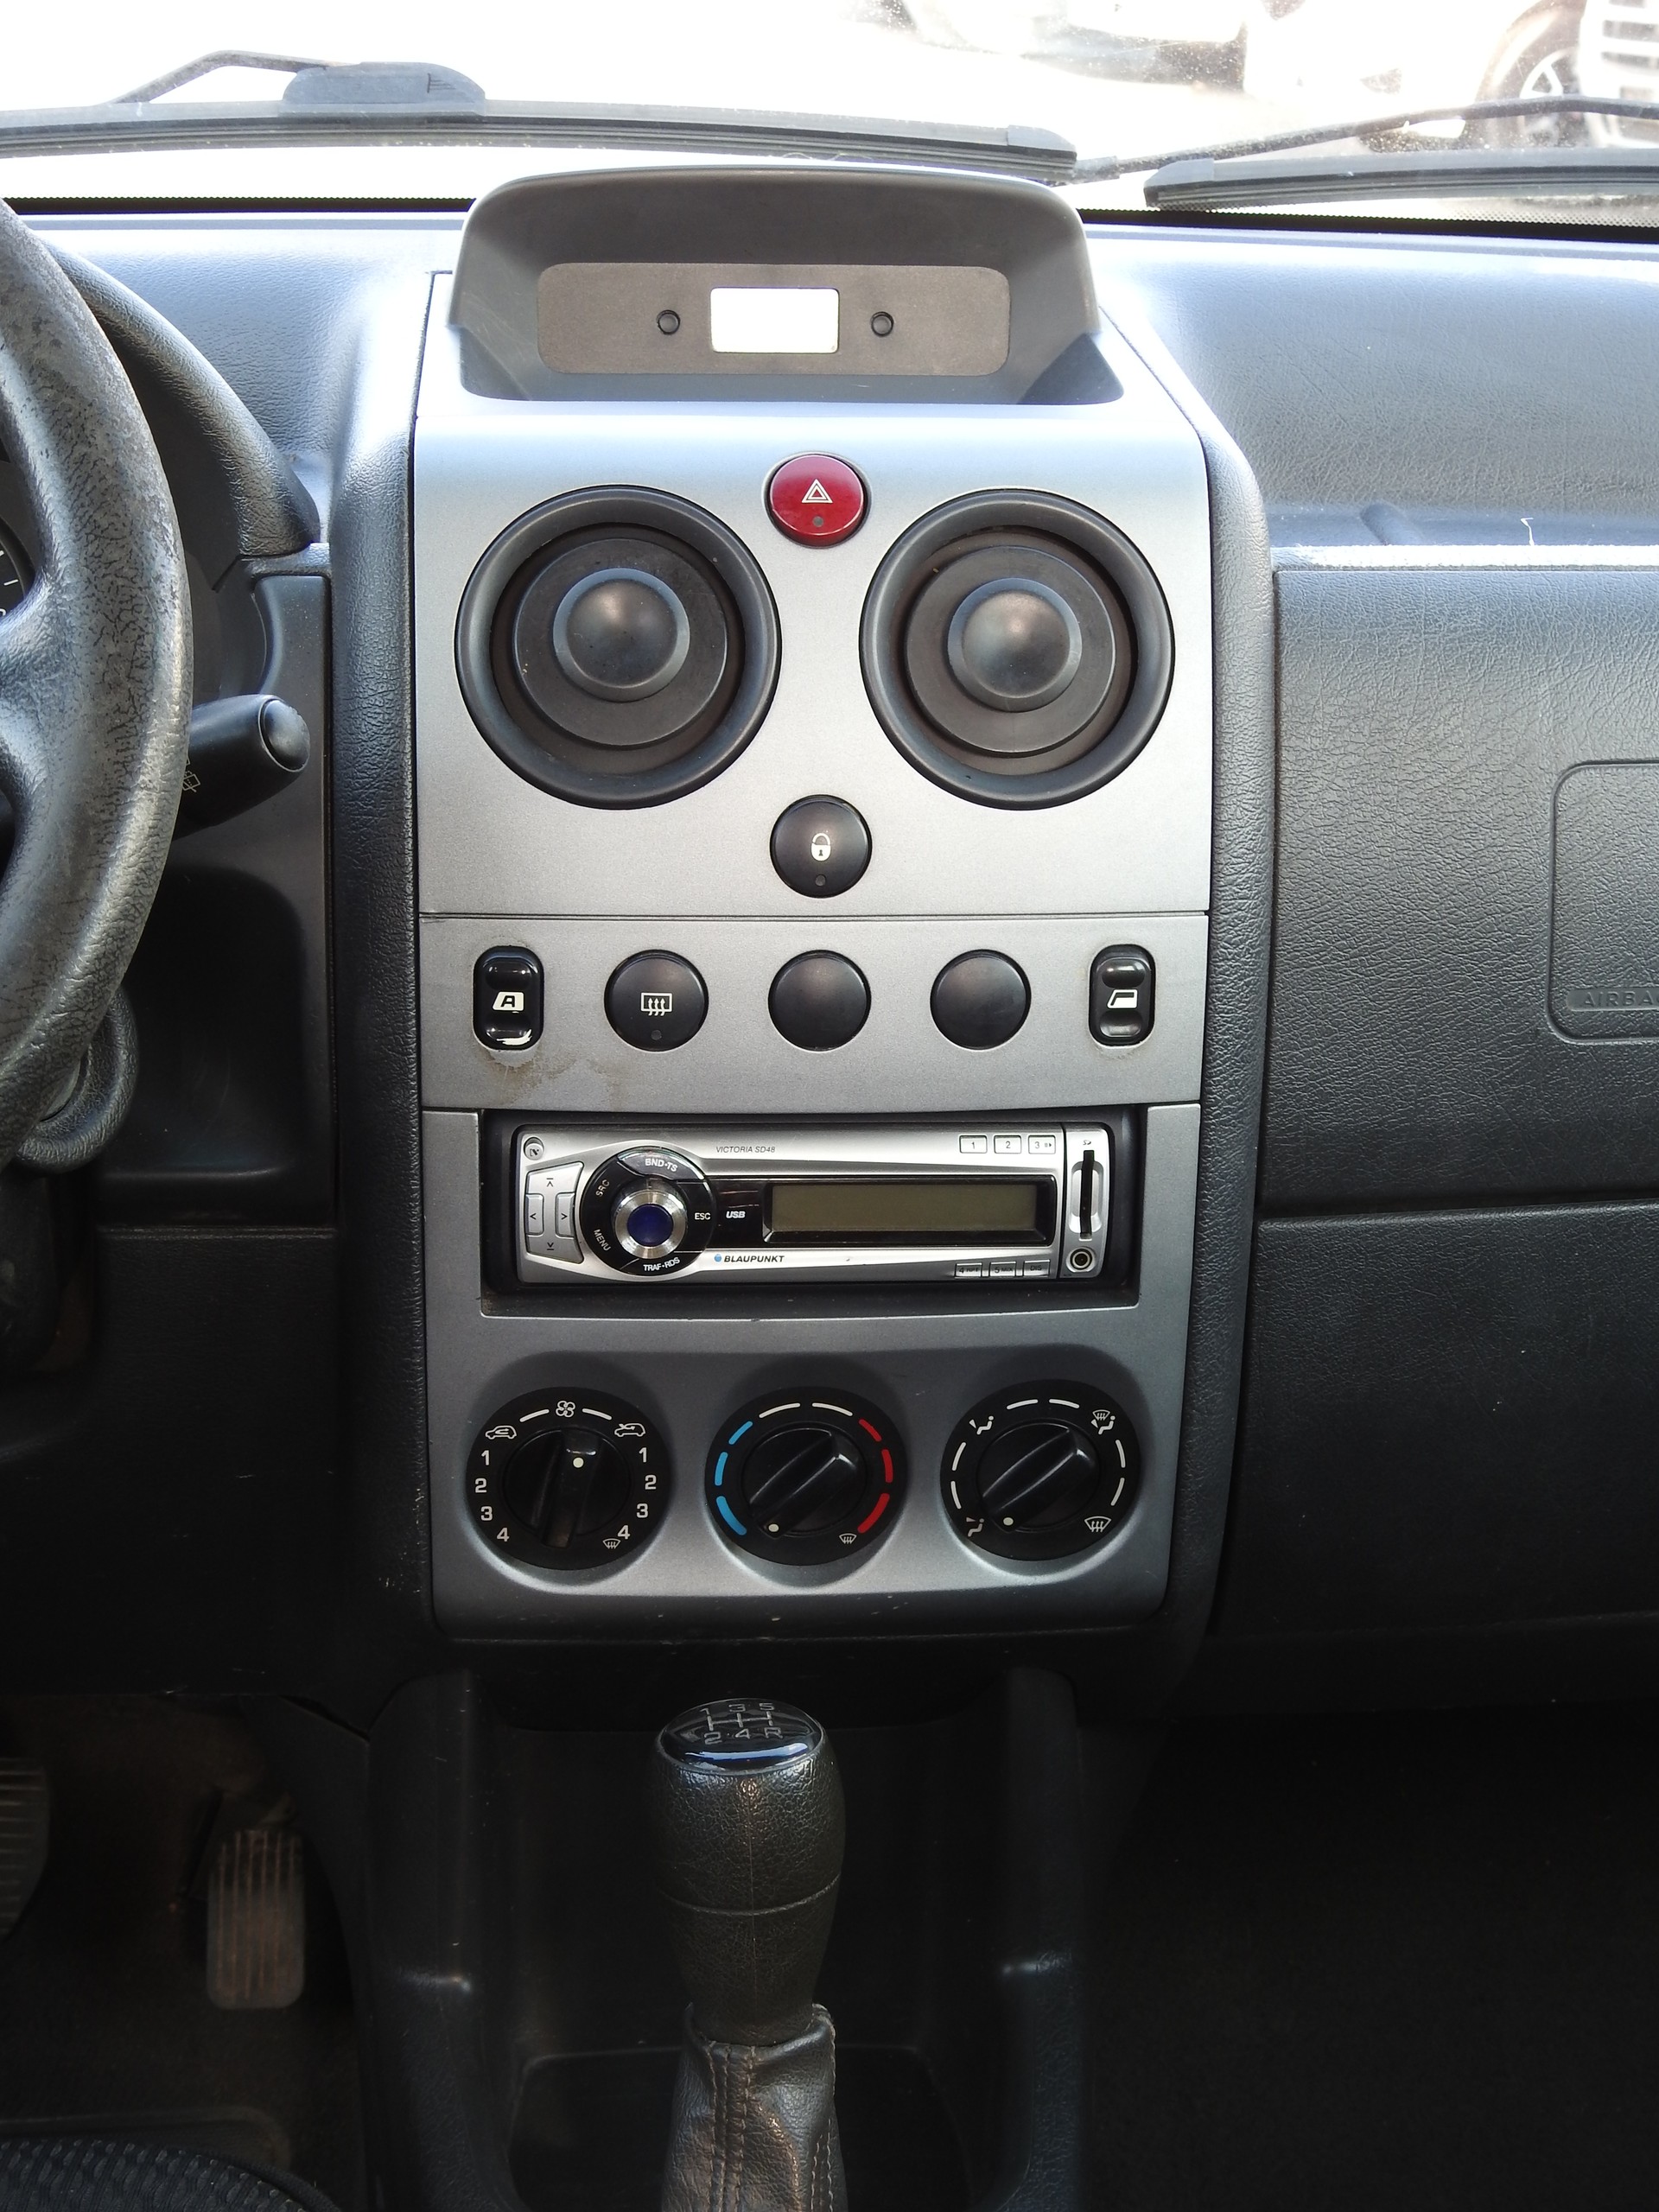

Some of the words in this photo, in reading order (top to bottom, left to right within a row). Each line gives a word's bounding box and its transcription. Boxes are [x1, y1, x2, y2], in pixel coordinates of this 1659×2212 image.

[500, 995, 515, 1007] A
[1584, 989, 1659, 1007] AIRBA
[971, 1141, 976, 1149] 1
[1005, 1141, 1011, 1149] 2
[1034, 1141, 1039, 1149] 3
[595, 1179, 610, 1198] SRC
[726, 1211, 746, 1219] USB
[594, 1229, 612, 1251] MENU
[480, 1450, 490, 1465] 1
[639, 1447, 647, 1463] 1
[475, 1478, 487, 1493] 2
[645, 1474, 657, 1490] 2
[480, 1506, 493, 1521] 3
[636, 1503, 649, 1518] 3
[496, 1527, 510, 1542] 4
[617, 1525, 631, 1540] 4
[728, 1703, 746, 1713] 3
[759, 1702, 775, 1711] 5
[703, 1732, 722, 1745] 2
[735, 1728, 751, 1739] 4
[764, 1727, 784, 1739] R
